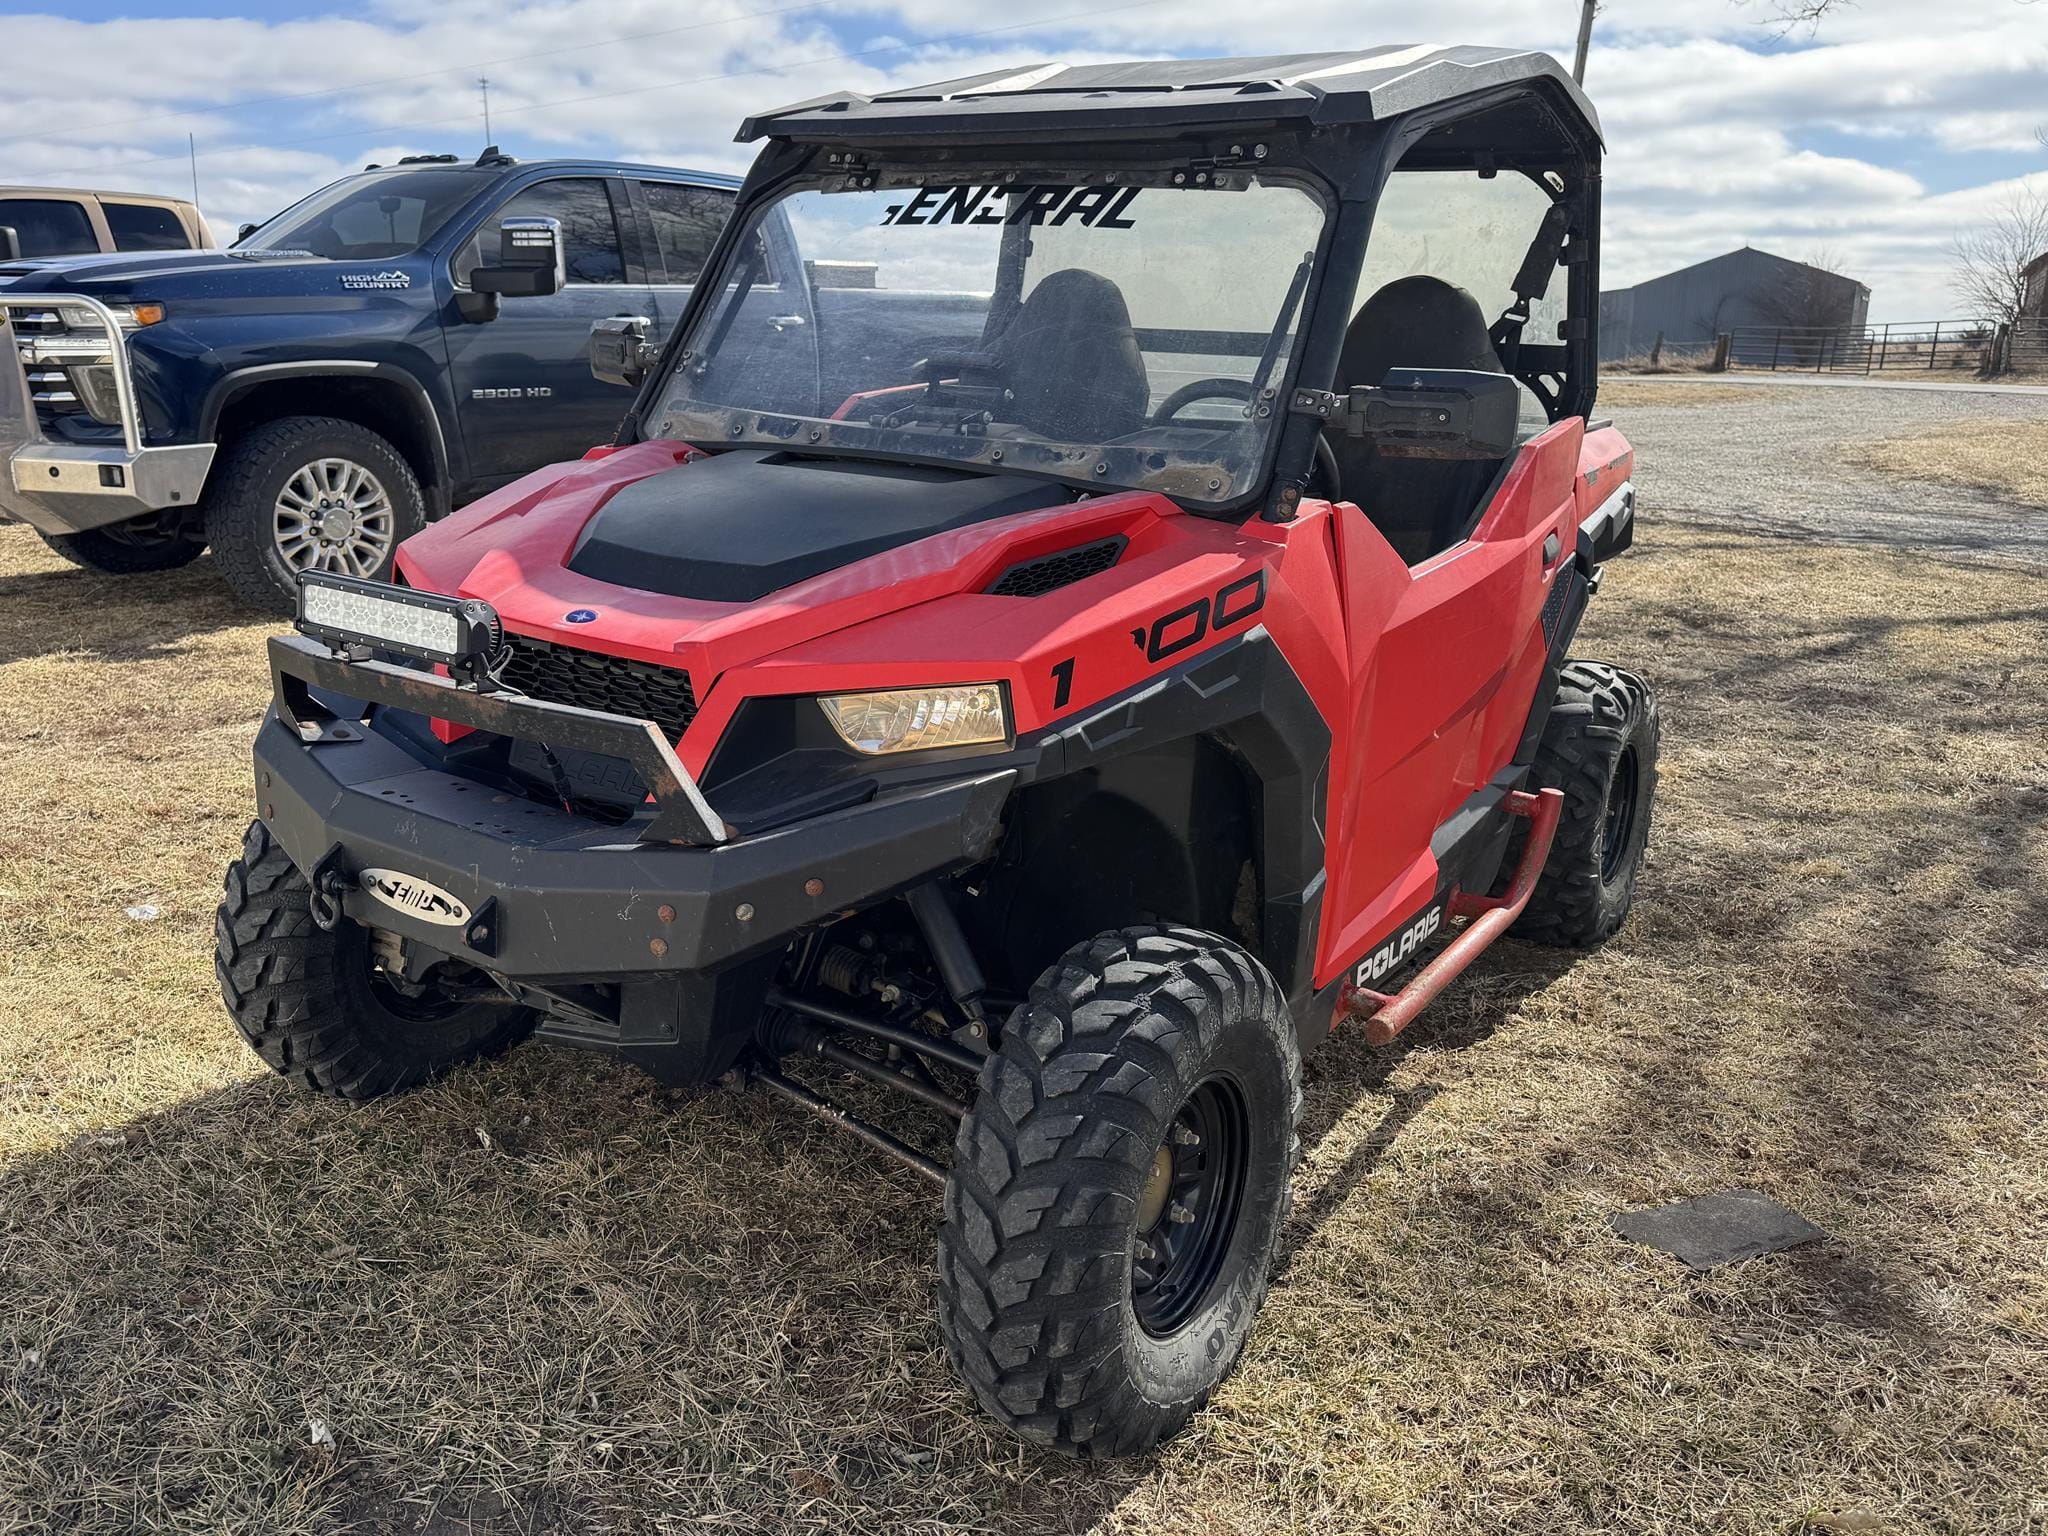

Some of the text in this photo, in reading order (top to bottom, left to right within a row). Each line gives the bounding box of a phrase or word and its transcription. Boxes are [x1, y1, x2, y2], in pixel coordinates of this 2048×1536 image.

[341, 274, 378, 282] HIGH
[344, 281, 410, 289] COUNTRY
[526, 387, 552, 397] HD
[1356, 905, 1441, 988] POLARIS
